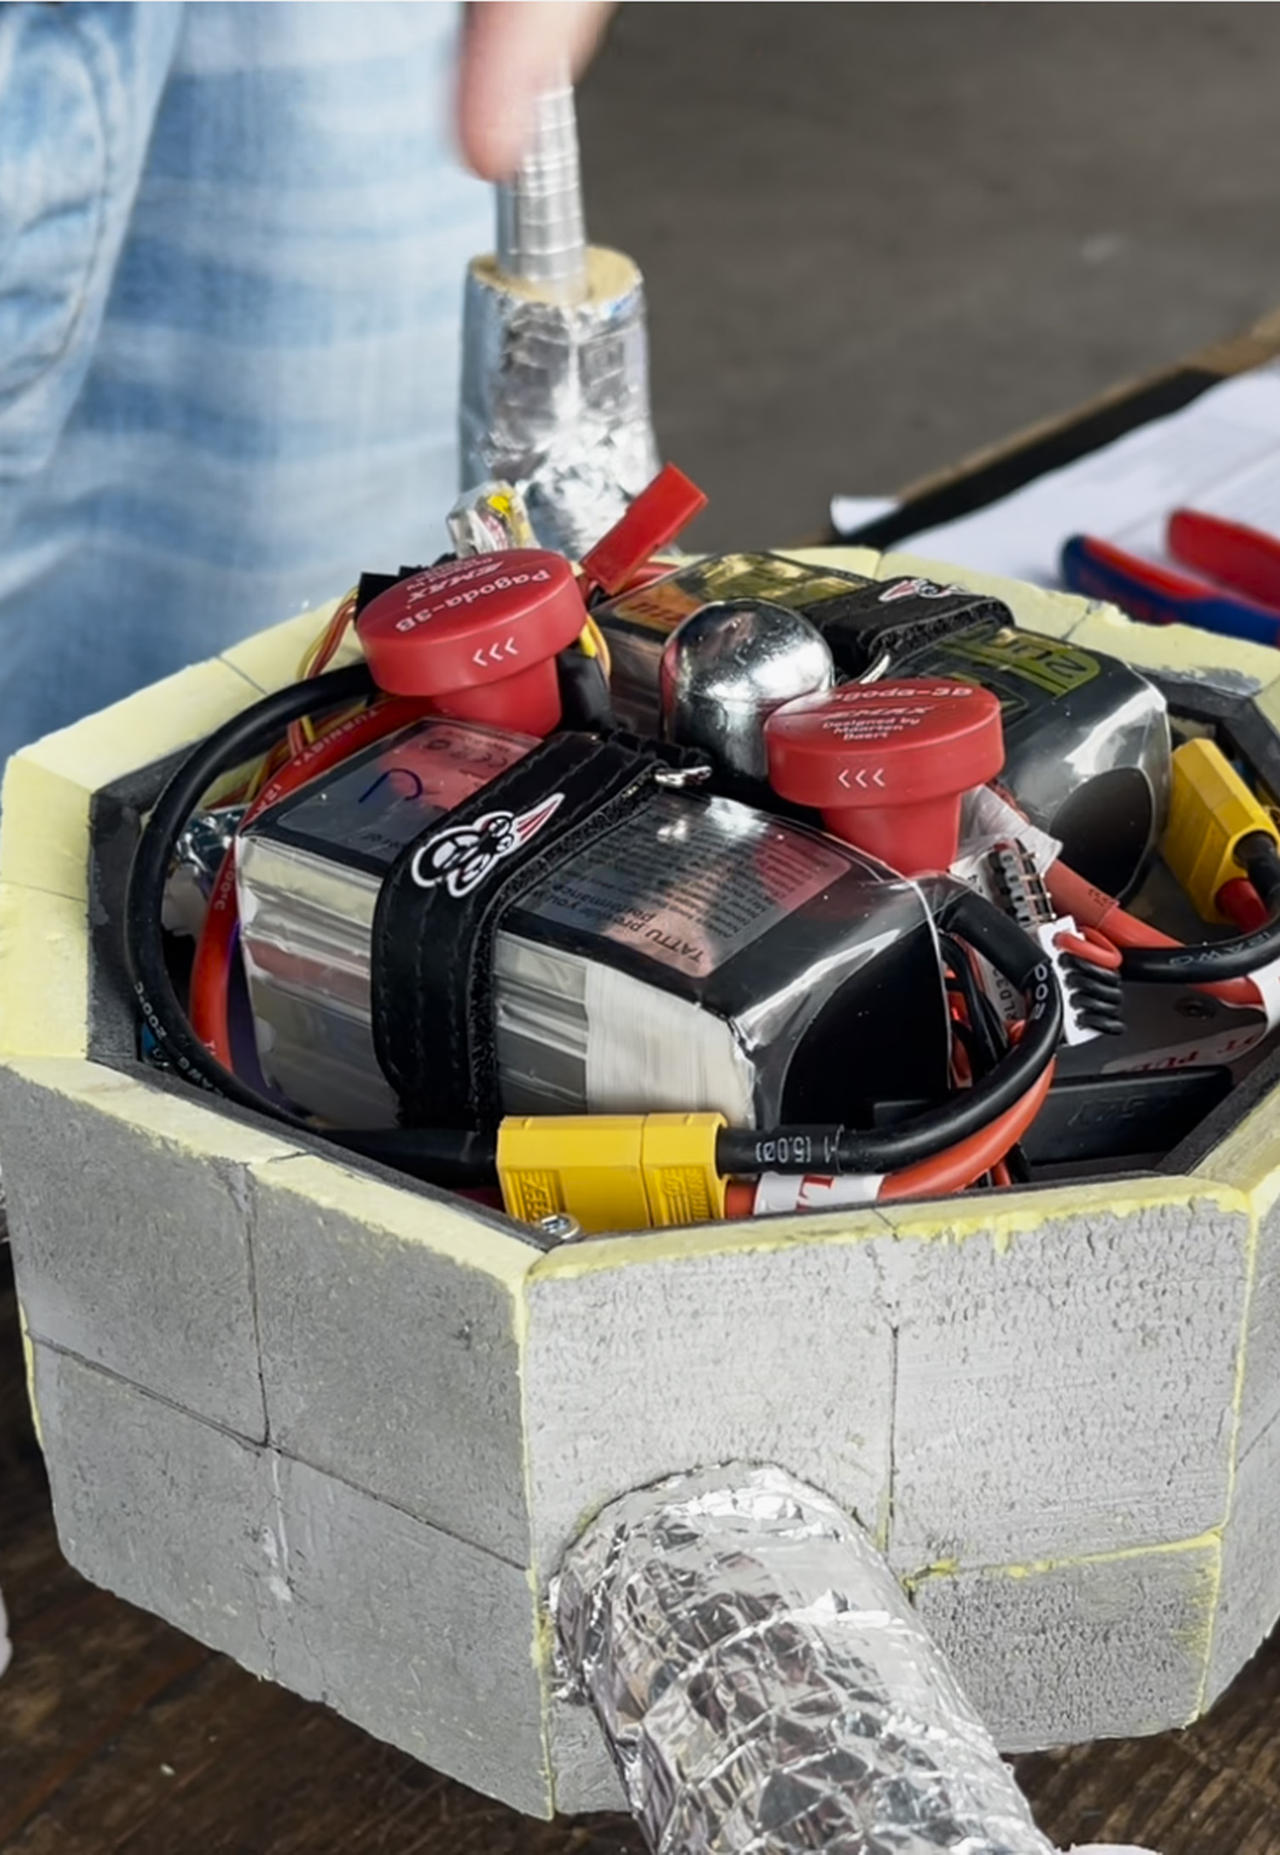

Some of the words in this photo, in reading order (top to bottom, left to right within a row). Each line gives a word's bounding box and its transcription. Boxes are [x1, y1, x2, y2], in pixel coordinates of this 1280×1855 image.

[395, 568, 552, 633] Pagoda-3B
[822, 718, 897, 729] Designed
[900, 717, 921, 727] by
[646, 926, 705, 963] TATTU
